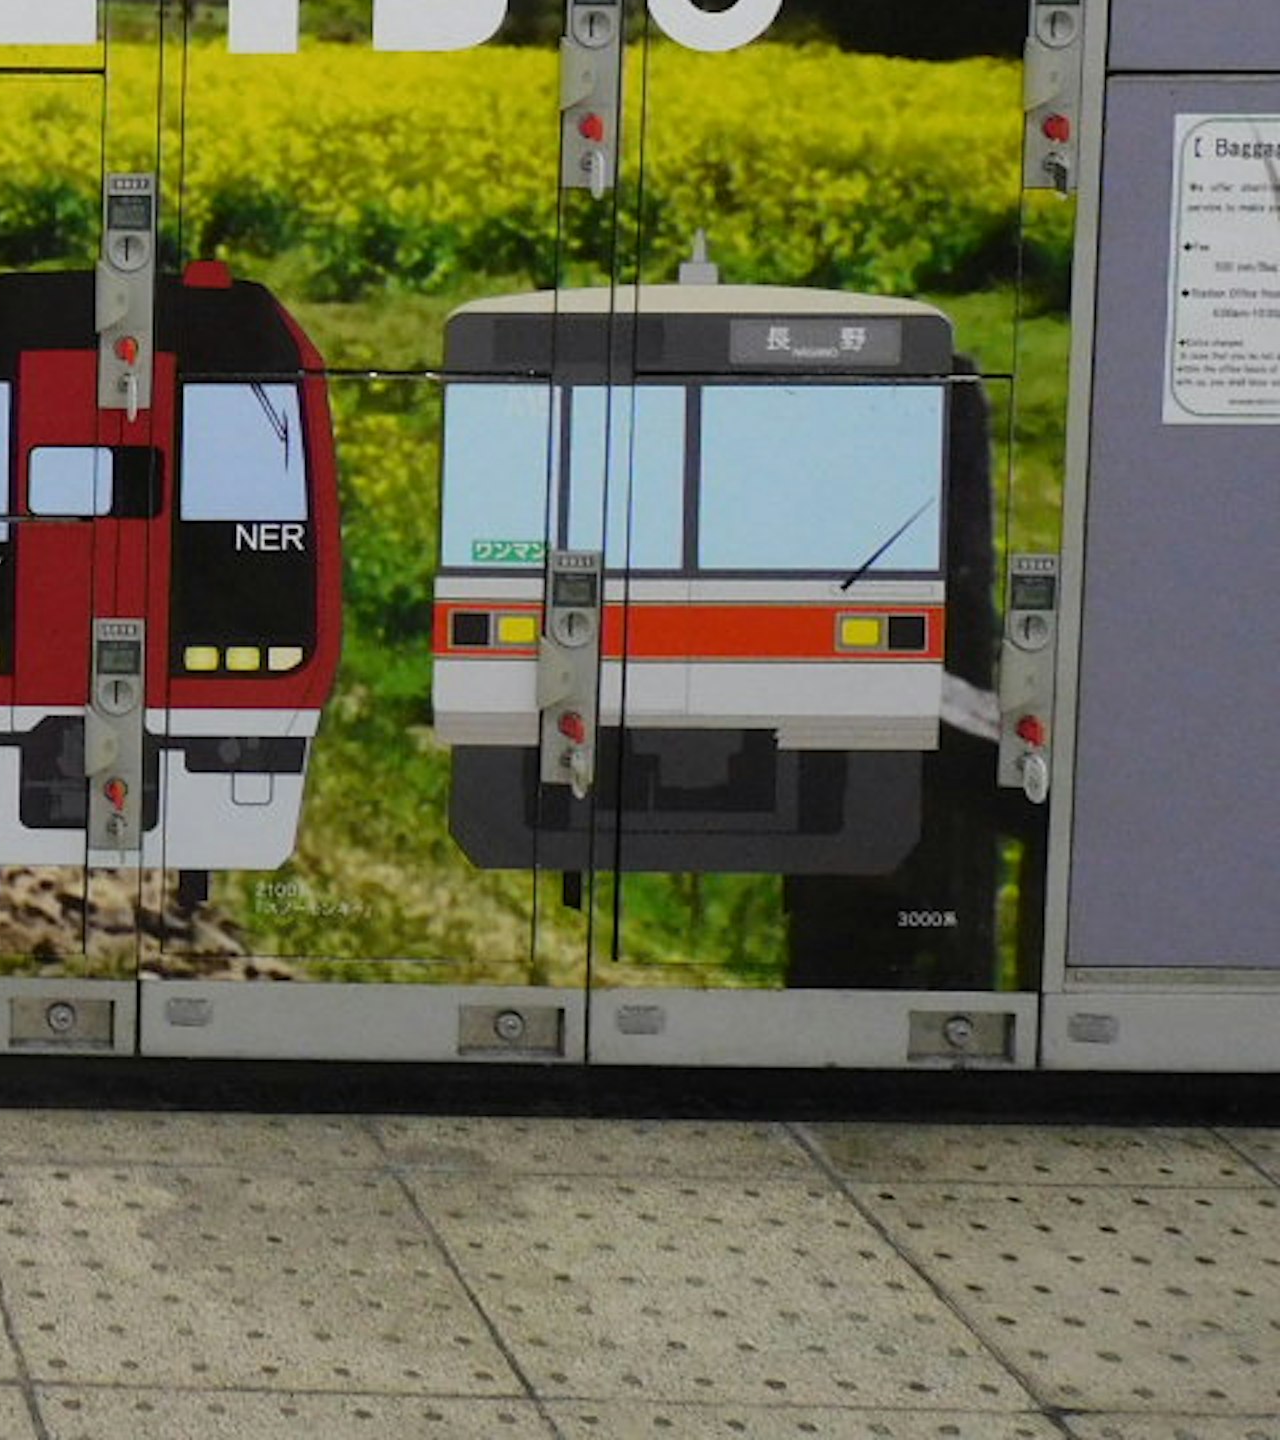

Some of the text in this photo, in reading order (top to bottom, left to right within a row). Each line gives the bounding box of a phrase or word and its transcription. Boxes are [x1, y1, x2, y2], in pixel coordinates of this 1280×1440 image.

[235, 523, 305, 552] NER
[474, 541, 545, 561] ワンマン
